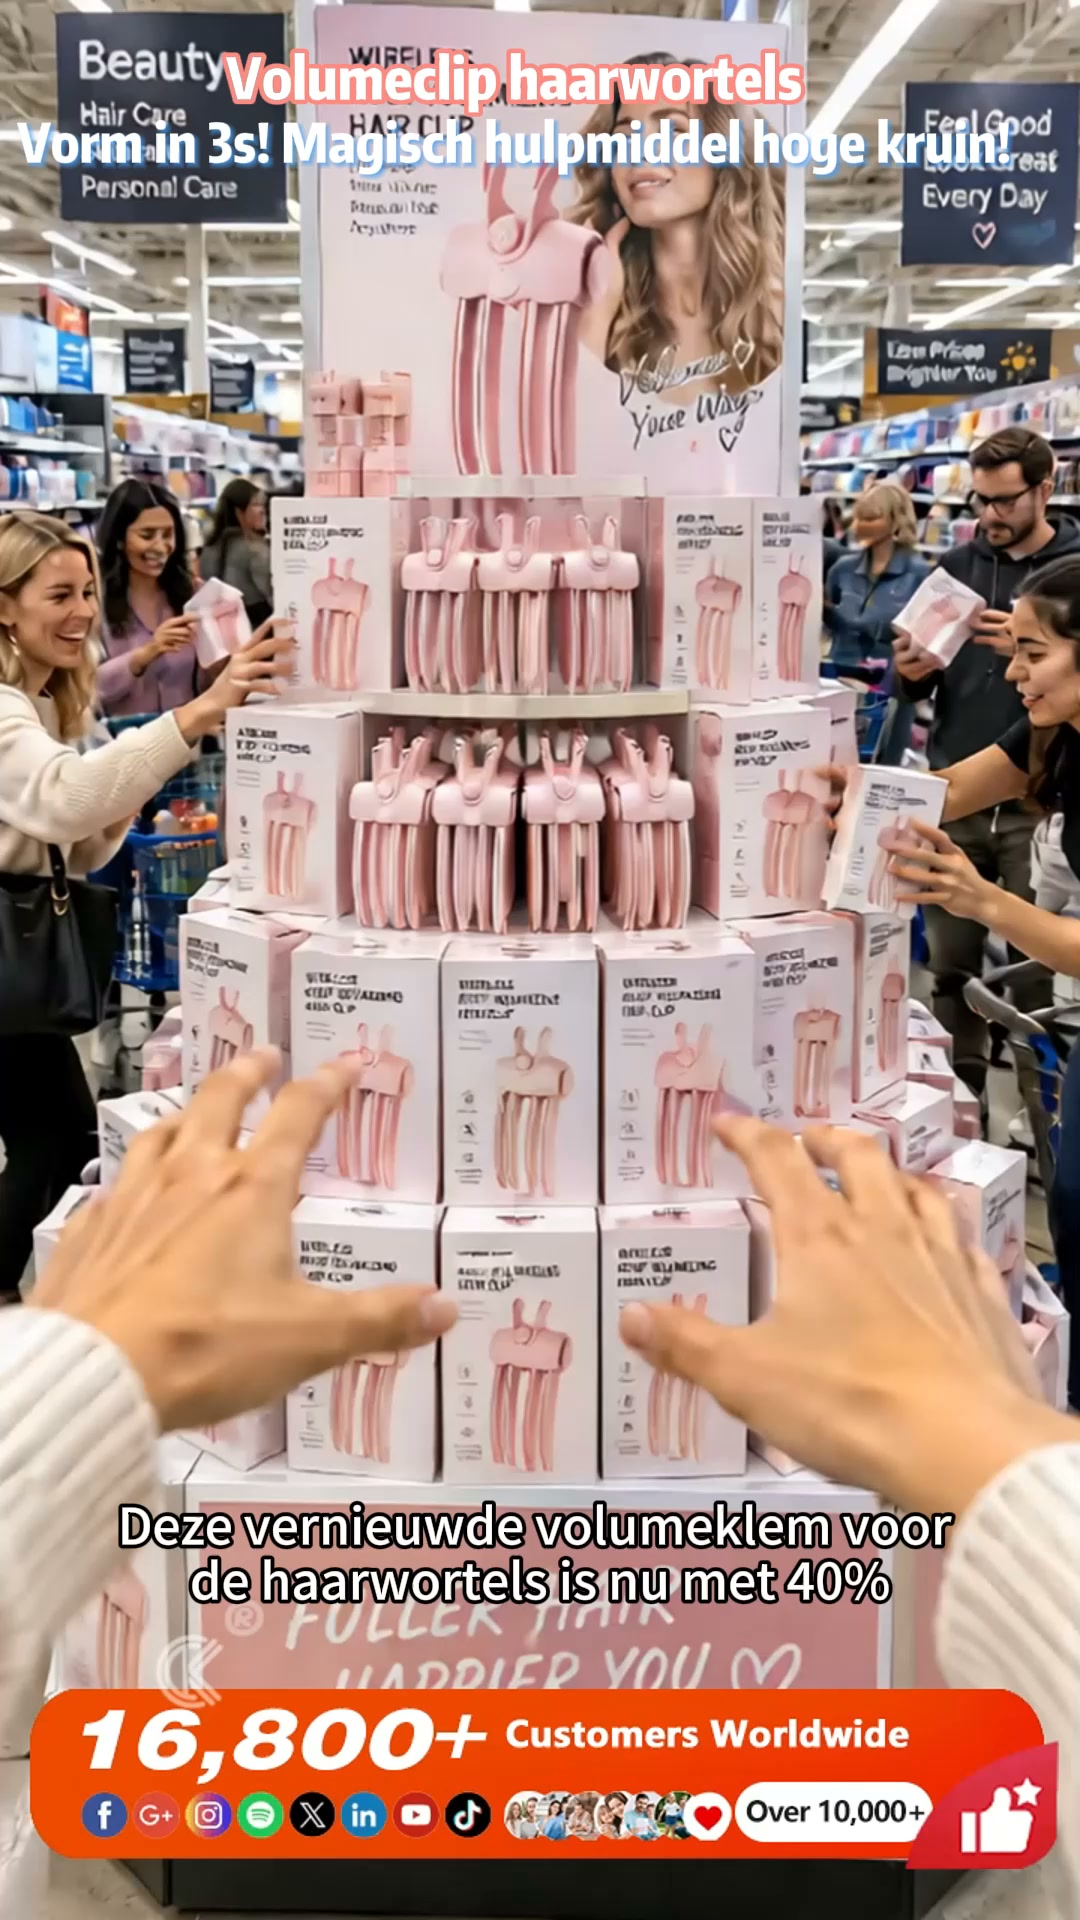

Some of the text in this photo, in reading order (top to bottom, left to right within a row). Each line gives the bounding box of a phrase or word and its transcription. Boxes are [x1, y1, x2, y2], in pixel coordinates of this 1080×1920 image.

[79, 40, 224, 91] Beauty
[80, 100, 187, 127] Hair Care
[985, 107, 1053, 137] Good
[81, 174, 178, 199] Personal
[922, 182, 1049, 215] Every Day
[604, 1642, 711, 1690] YOU
